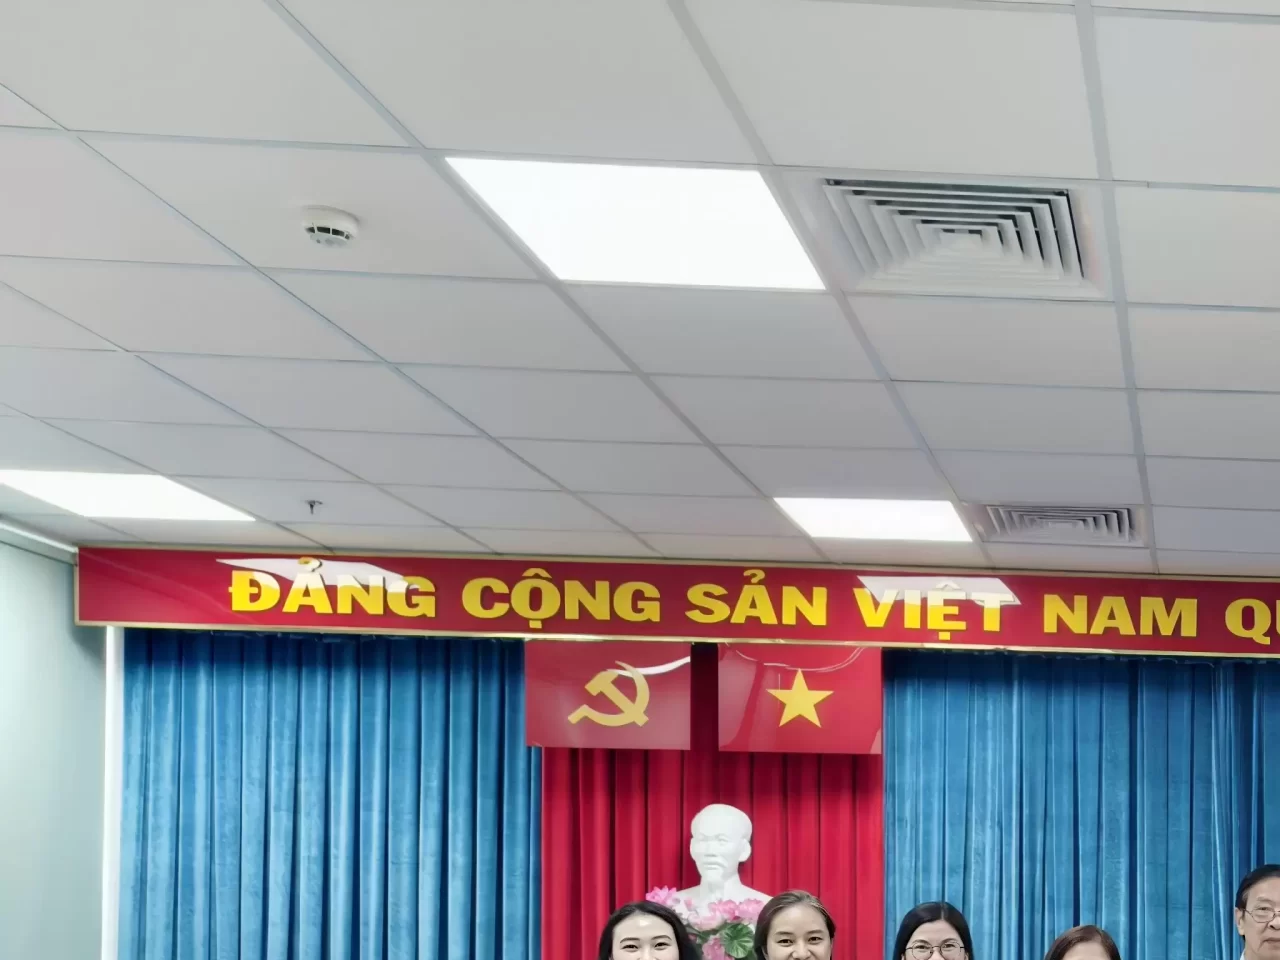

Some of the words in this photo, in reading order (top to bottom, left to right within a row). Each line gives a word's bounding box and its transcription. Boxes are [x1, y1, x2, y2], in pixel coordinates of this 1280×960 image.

[228, 557, 436, 618] ĐẢNG
[462, 567, 661, 629] CỘNG
[685, 570, 828, 626] SẢN
[853, 582, 1004, 641] VIỆT
[1043, 594, 1198, 637] NAM
